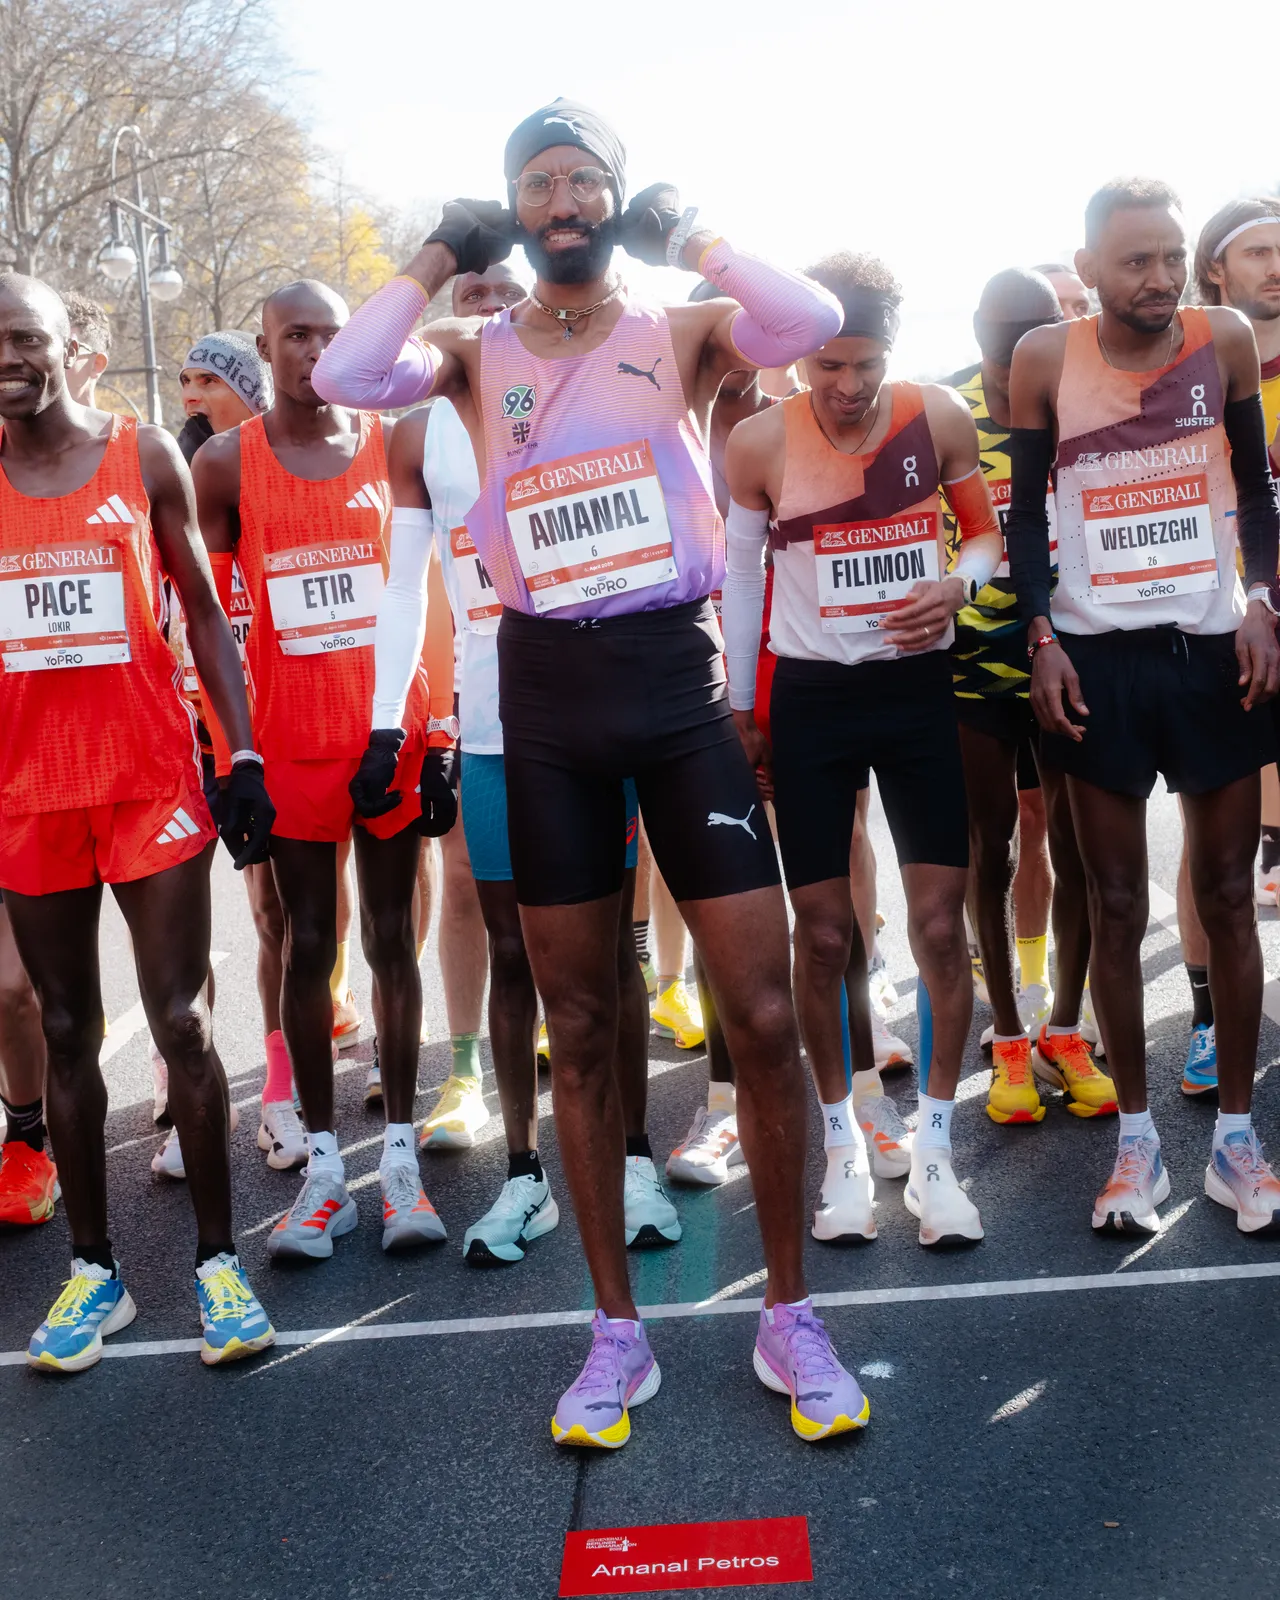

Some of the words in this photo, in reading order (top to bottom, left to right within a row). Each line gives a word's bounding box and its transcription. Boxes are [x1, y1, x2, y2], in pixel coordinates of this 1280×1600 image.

[505, 388, 534, 415] 96
[1183, 416, 1215, 427] USTER
[1104, 444, 1208, 470] GENERALI
[539, 450, 645, 491] GENERALI
[1115, 481, 1201, 510] GENERALI
[528, 488, 650, 550] AMANAL
[847, 519, 930, 545] GENERALI
[1100, 516, 1198, 551] WELDEZGHI
[22, 547, 116, 571] GENERALI
[295, 543, 375, 568] GENERALI
[591, 545, 598, 558] 6
[1147, 556, 1158, 566] 26
[832, 548, 926, 588] FILIMON
[24, 579, 93, 619] PACE
[302, 573, 355, 610] ETIR
[581, 577, 627, 597] YoPRO
[878, 590, 886, 600] 18
[1137, 584, 1176, 598] YoPRO
[48, 621, 71, 633] LOKIR
[330, 611, 336, 620] 5
[320, 636, 356, 650] YoPRO
[44, 653, 83, 666] YoPRO
[591, 1559, 688, 1577] Amanal
[698, 1555, 780, 1571] Petros
